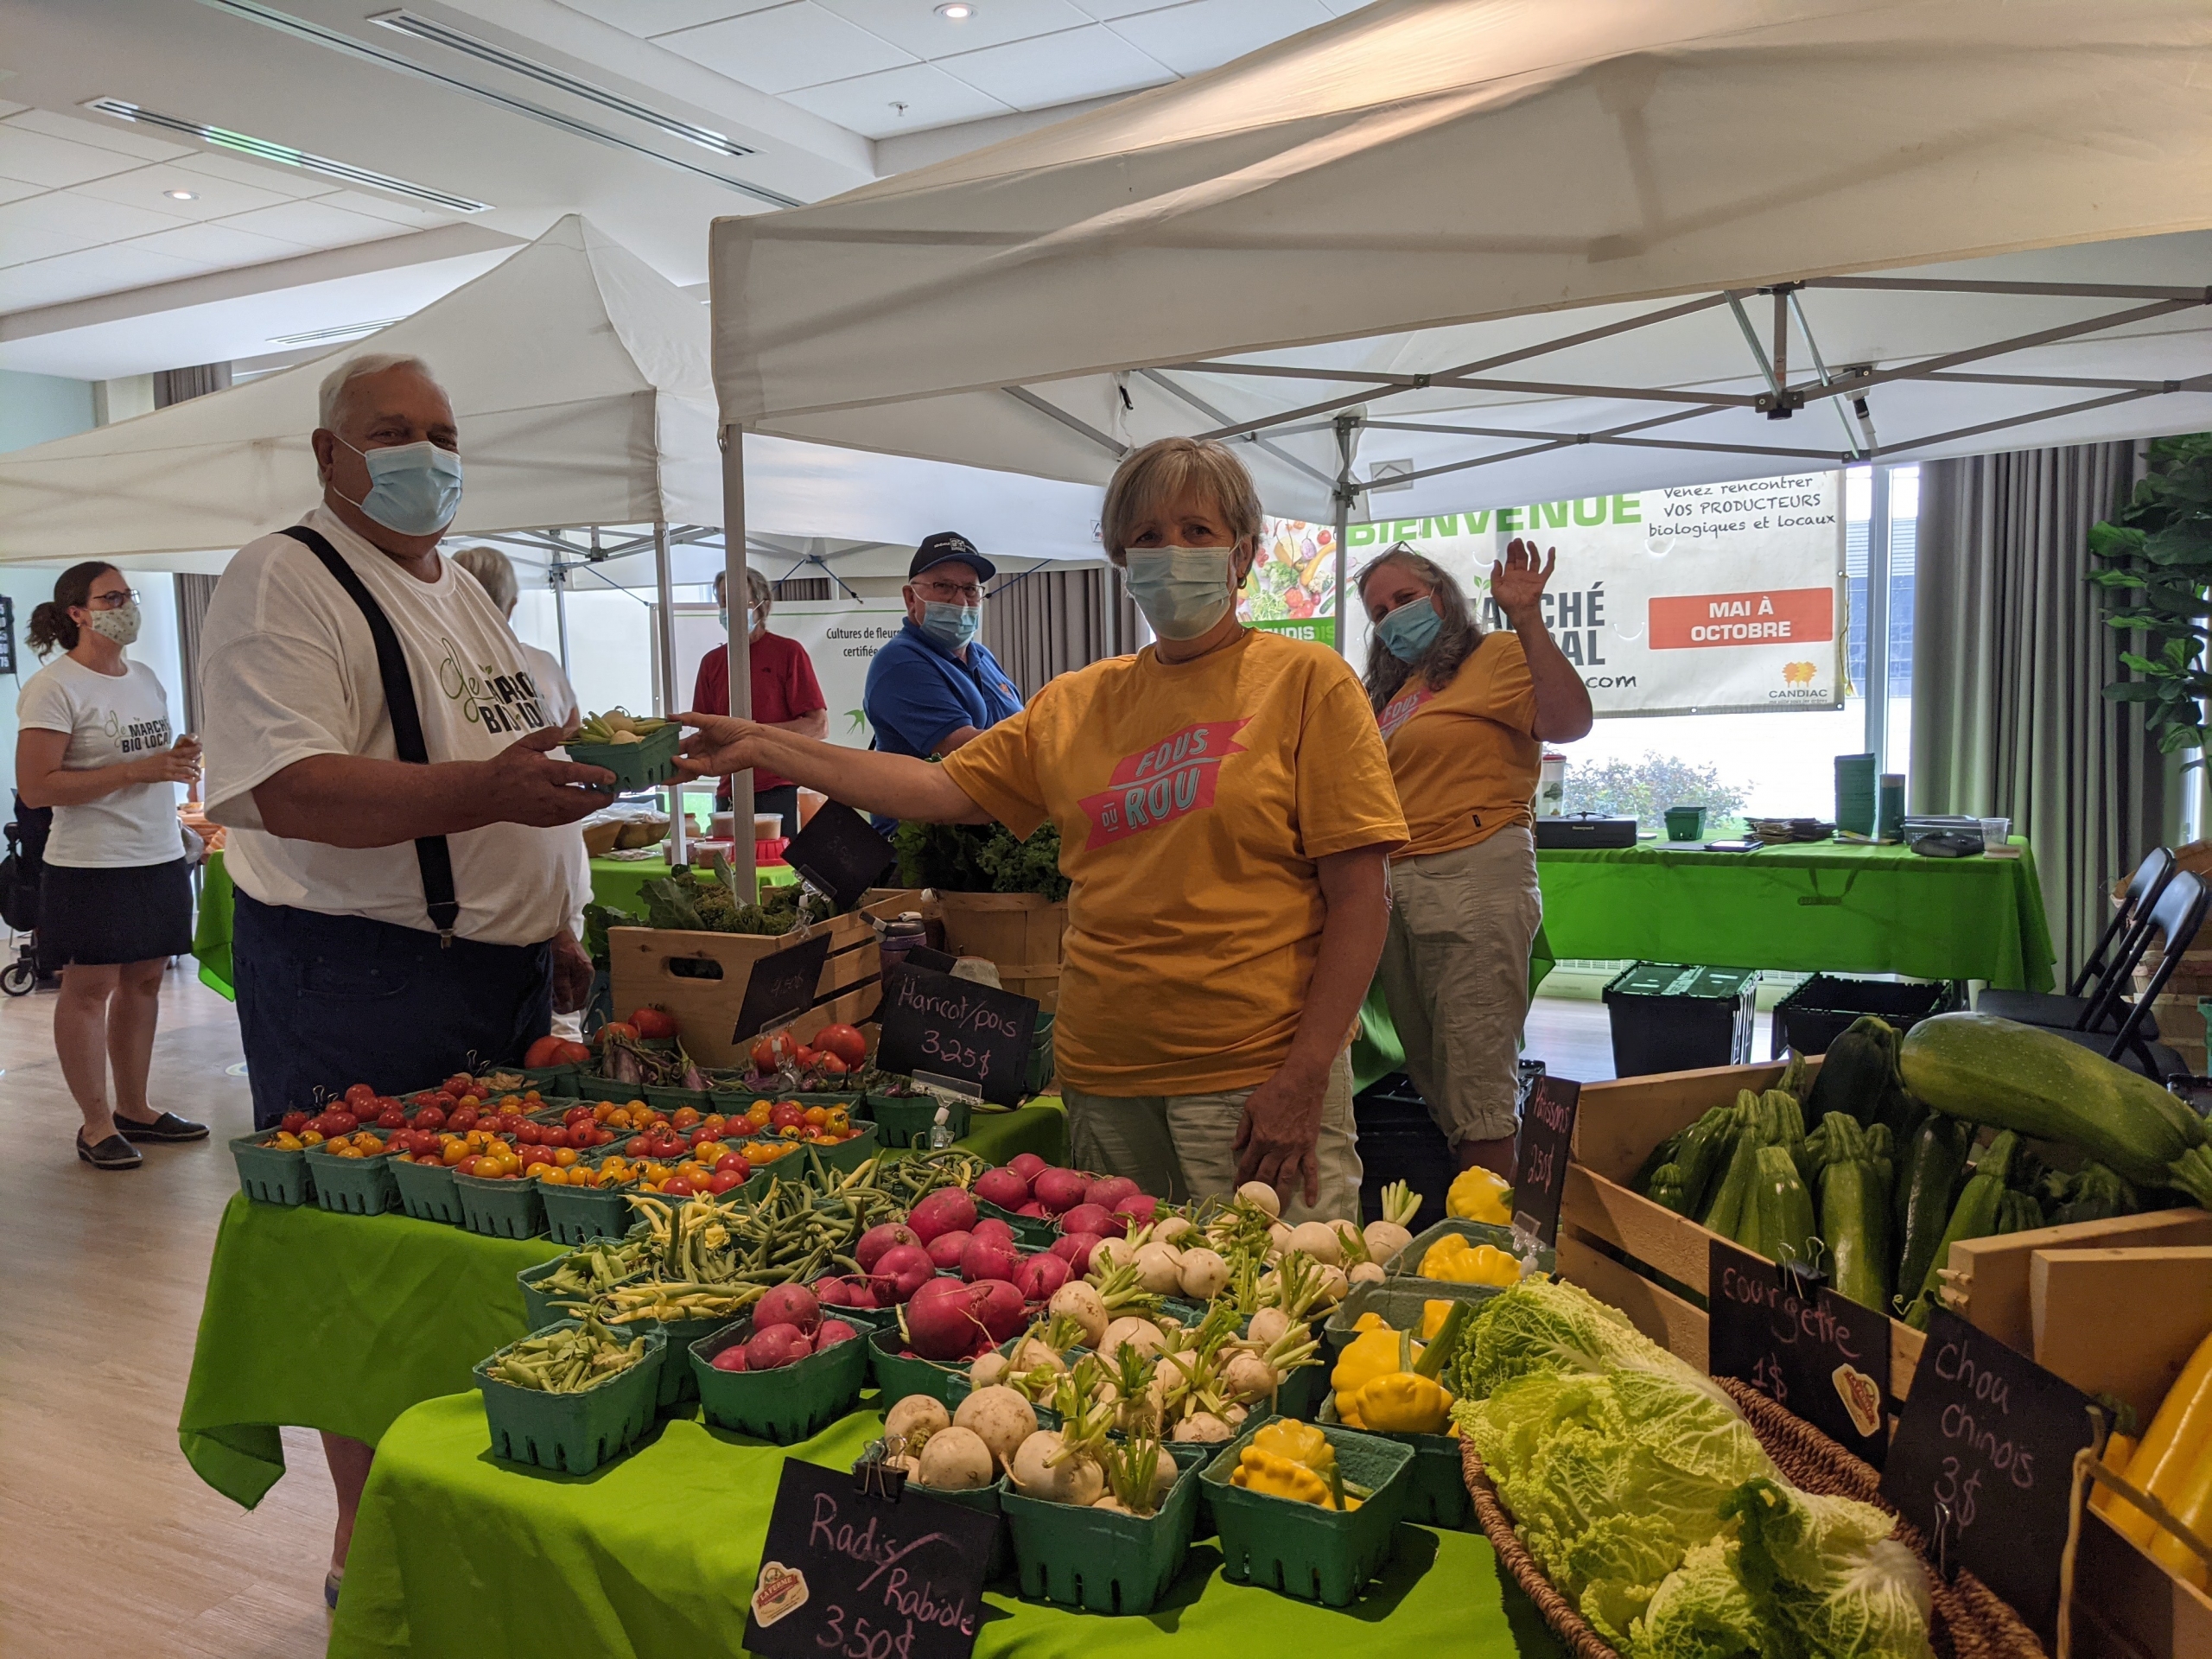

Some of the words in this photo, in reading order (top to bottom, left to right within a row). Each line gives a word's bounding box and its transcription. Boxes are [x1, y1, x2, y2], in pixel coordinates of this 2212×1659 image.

[1664, 487, 1713, 499] Venez
[1721, 476, 1814, 494] rencontrer
[1664, 504, 1693, 517] VOS
[1700, 493, 1821, 514] PRODUCTEURS
[1346, 493, 1643, 547] BIENVENUE
[1649, 521, 1746, 538] biologiques
[1753, 517, 1770, 529] et
[1778, 515, 1836, 527] locaux
[1709, 601, 1751, 619] MAI
[1758, 596, 1774, 616] À
[826, 627, 862, 639] Cultures
[864, 627, 874, 639] de
[1691, 621, 1791, 642] OCTOBRE
[1768, 689, 1828, 698] CANDIAC
[1383, 691, 1421, 723] FOUS
[121, 737, 143, 753] BIO
[1135, 728, 1210, 778] FOUS
[1101, 808, 1119, 828] DU
[1124, 767, 1200, 830] ROU
[760, 1592, 770, 1601] LA
[768, 1576, 793, 1593] FERME
